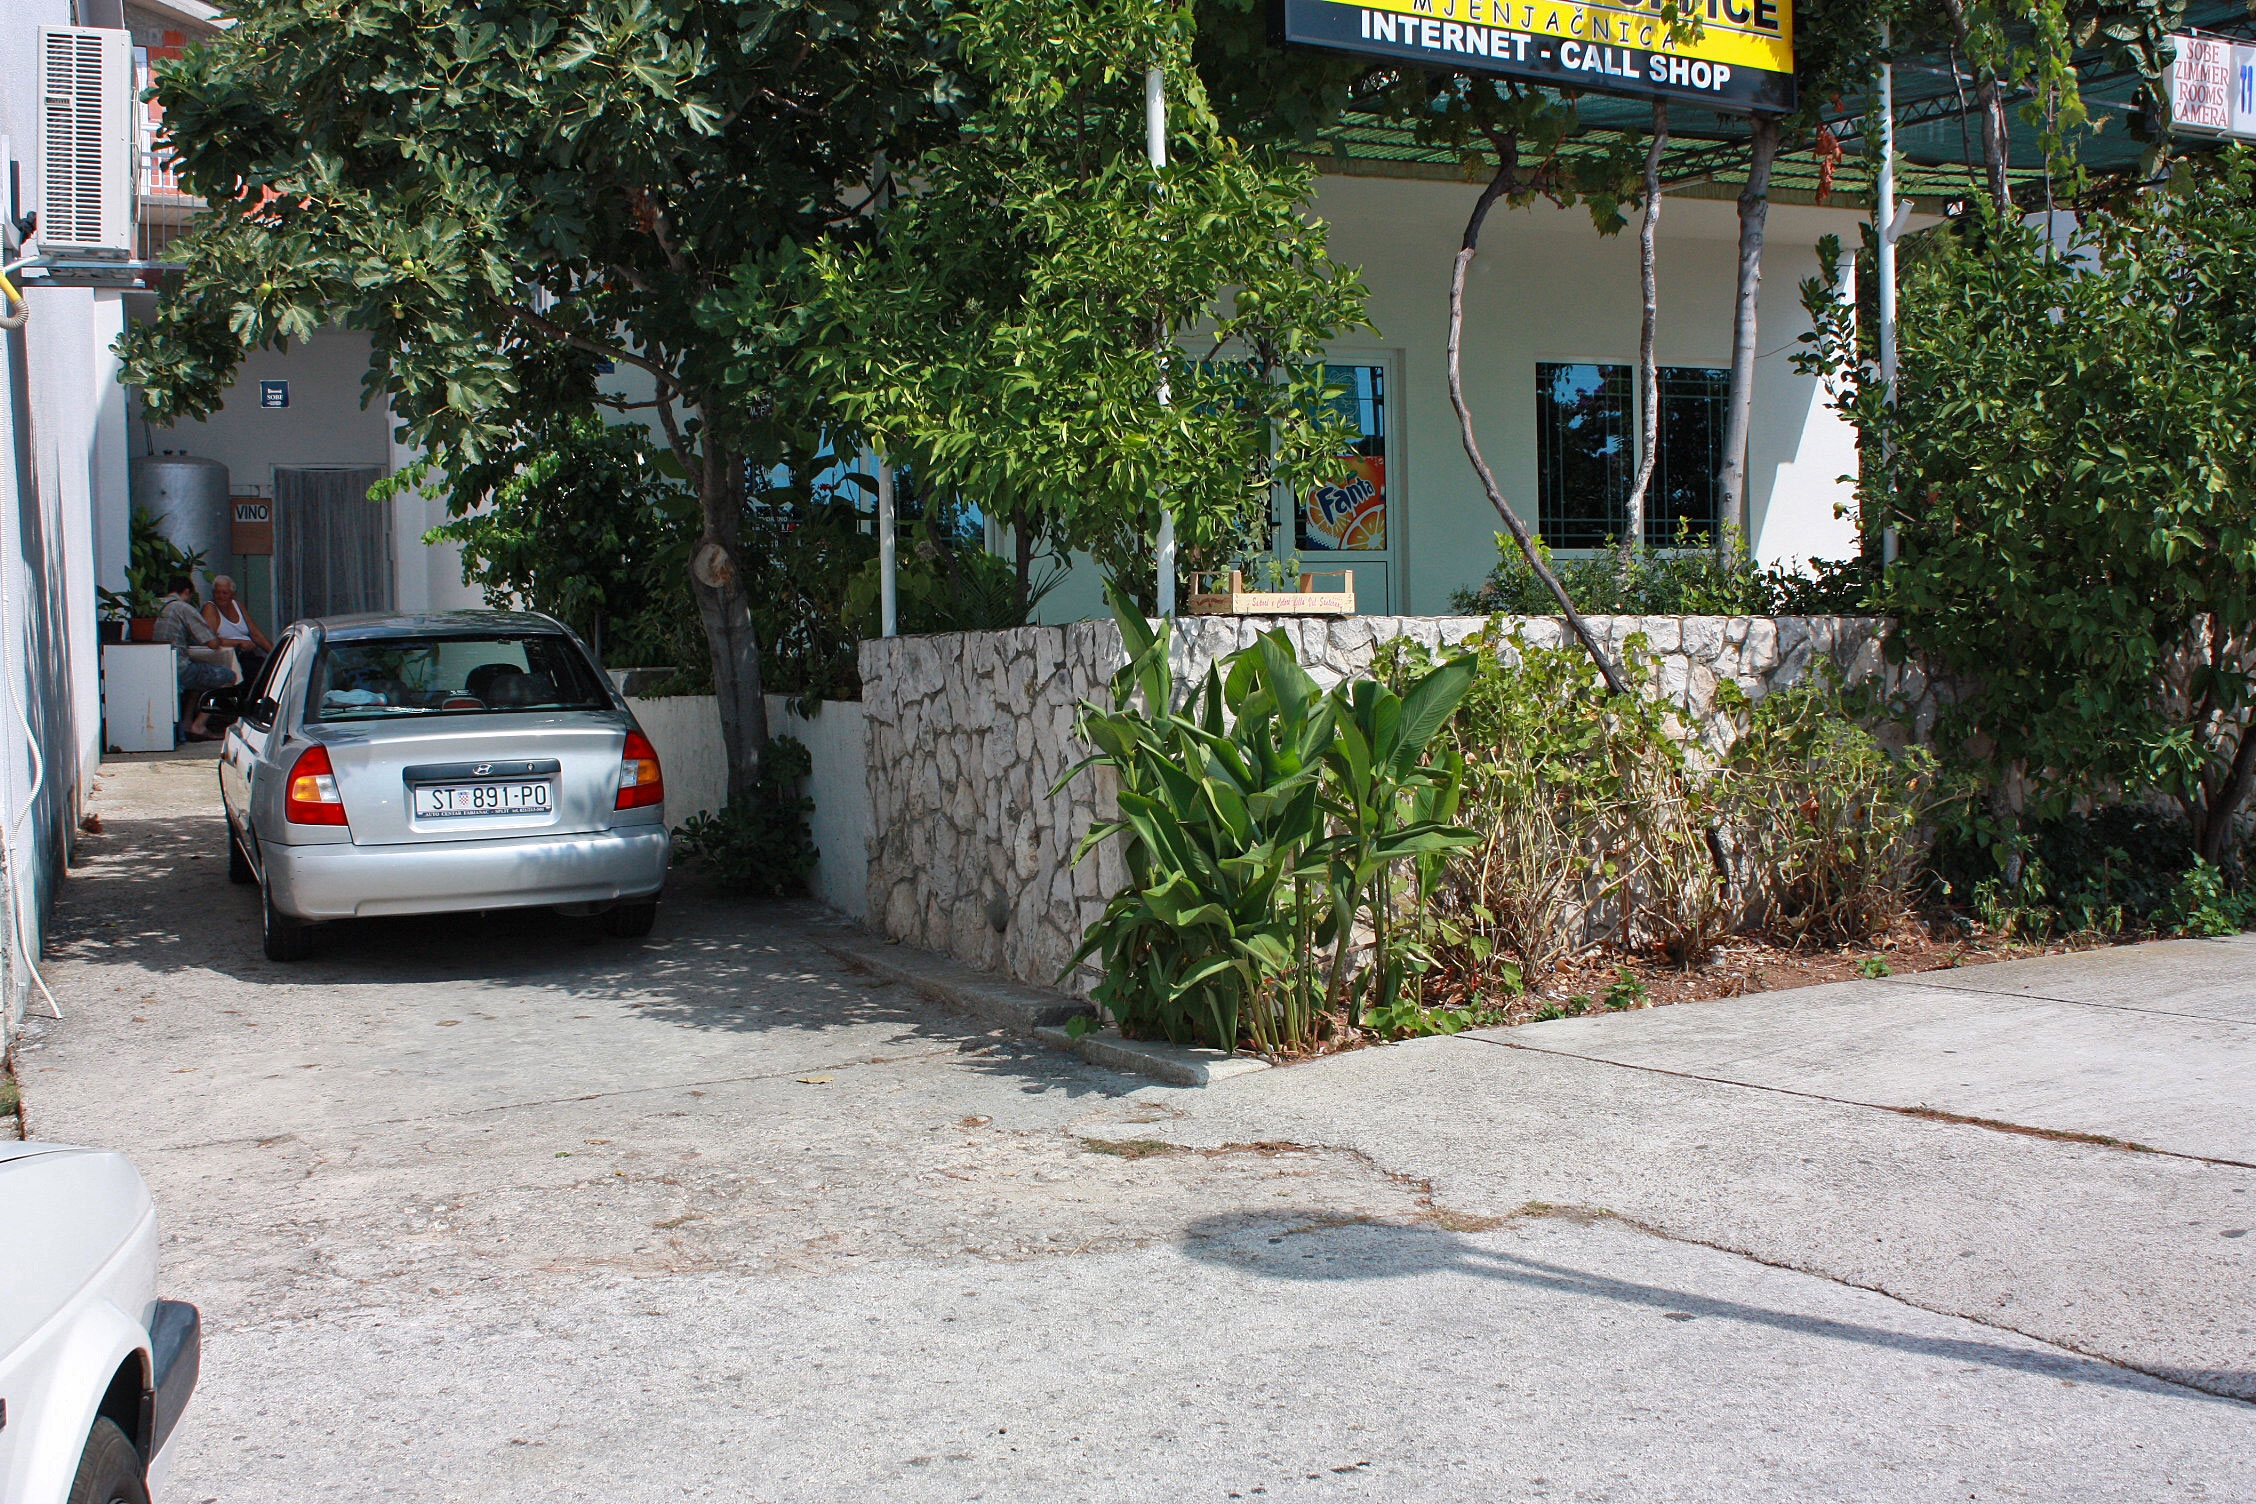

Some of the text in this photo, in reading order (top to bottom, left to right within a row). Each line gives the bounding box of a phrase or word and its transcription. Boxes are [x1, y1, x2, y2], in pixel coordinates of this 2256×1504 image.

[1361, 9, 1532, 62] INTERNET
[1560, 40, 1640, 79] CALL
[1648, 54, 1731, 91] SHOP
[2186, 41, 2220, 64] SOBE
[2175, 60, 2229, 87] ZIMMER
[2179, 81, 2224, 106] ROOMS
[2173, 101, 2228, 127] CAMERA
[235, 504, 269, 520] VINO
[1316, 476, 1376, 526] Fanta
[432, 785, 547, 810] ST 891-PO
